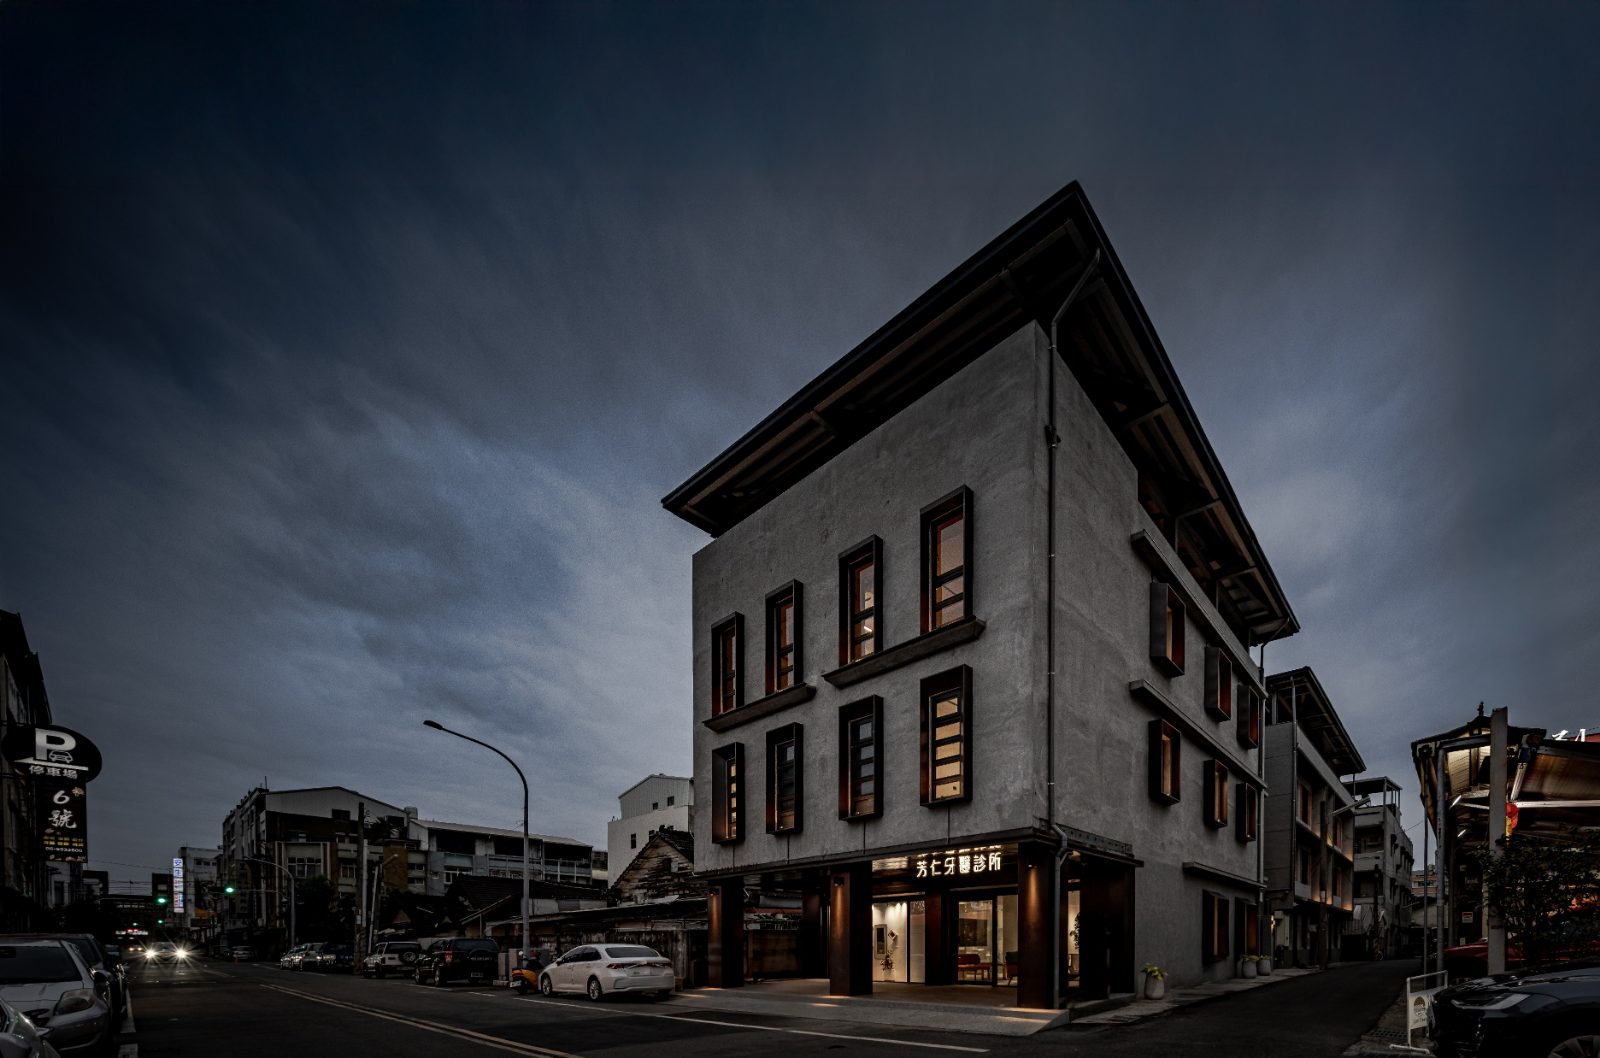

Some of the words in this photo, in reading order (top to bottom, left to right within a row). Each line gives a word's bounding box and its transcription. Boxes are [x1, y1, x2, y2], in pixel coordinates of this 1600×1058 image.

[35, 728, 76, 760] P
[29, 765, 78, 780] 停車場
[916, 852, 1002, 877] 芳仁牙醫診所
